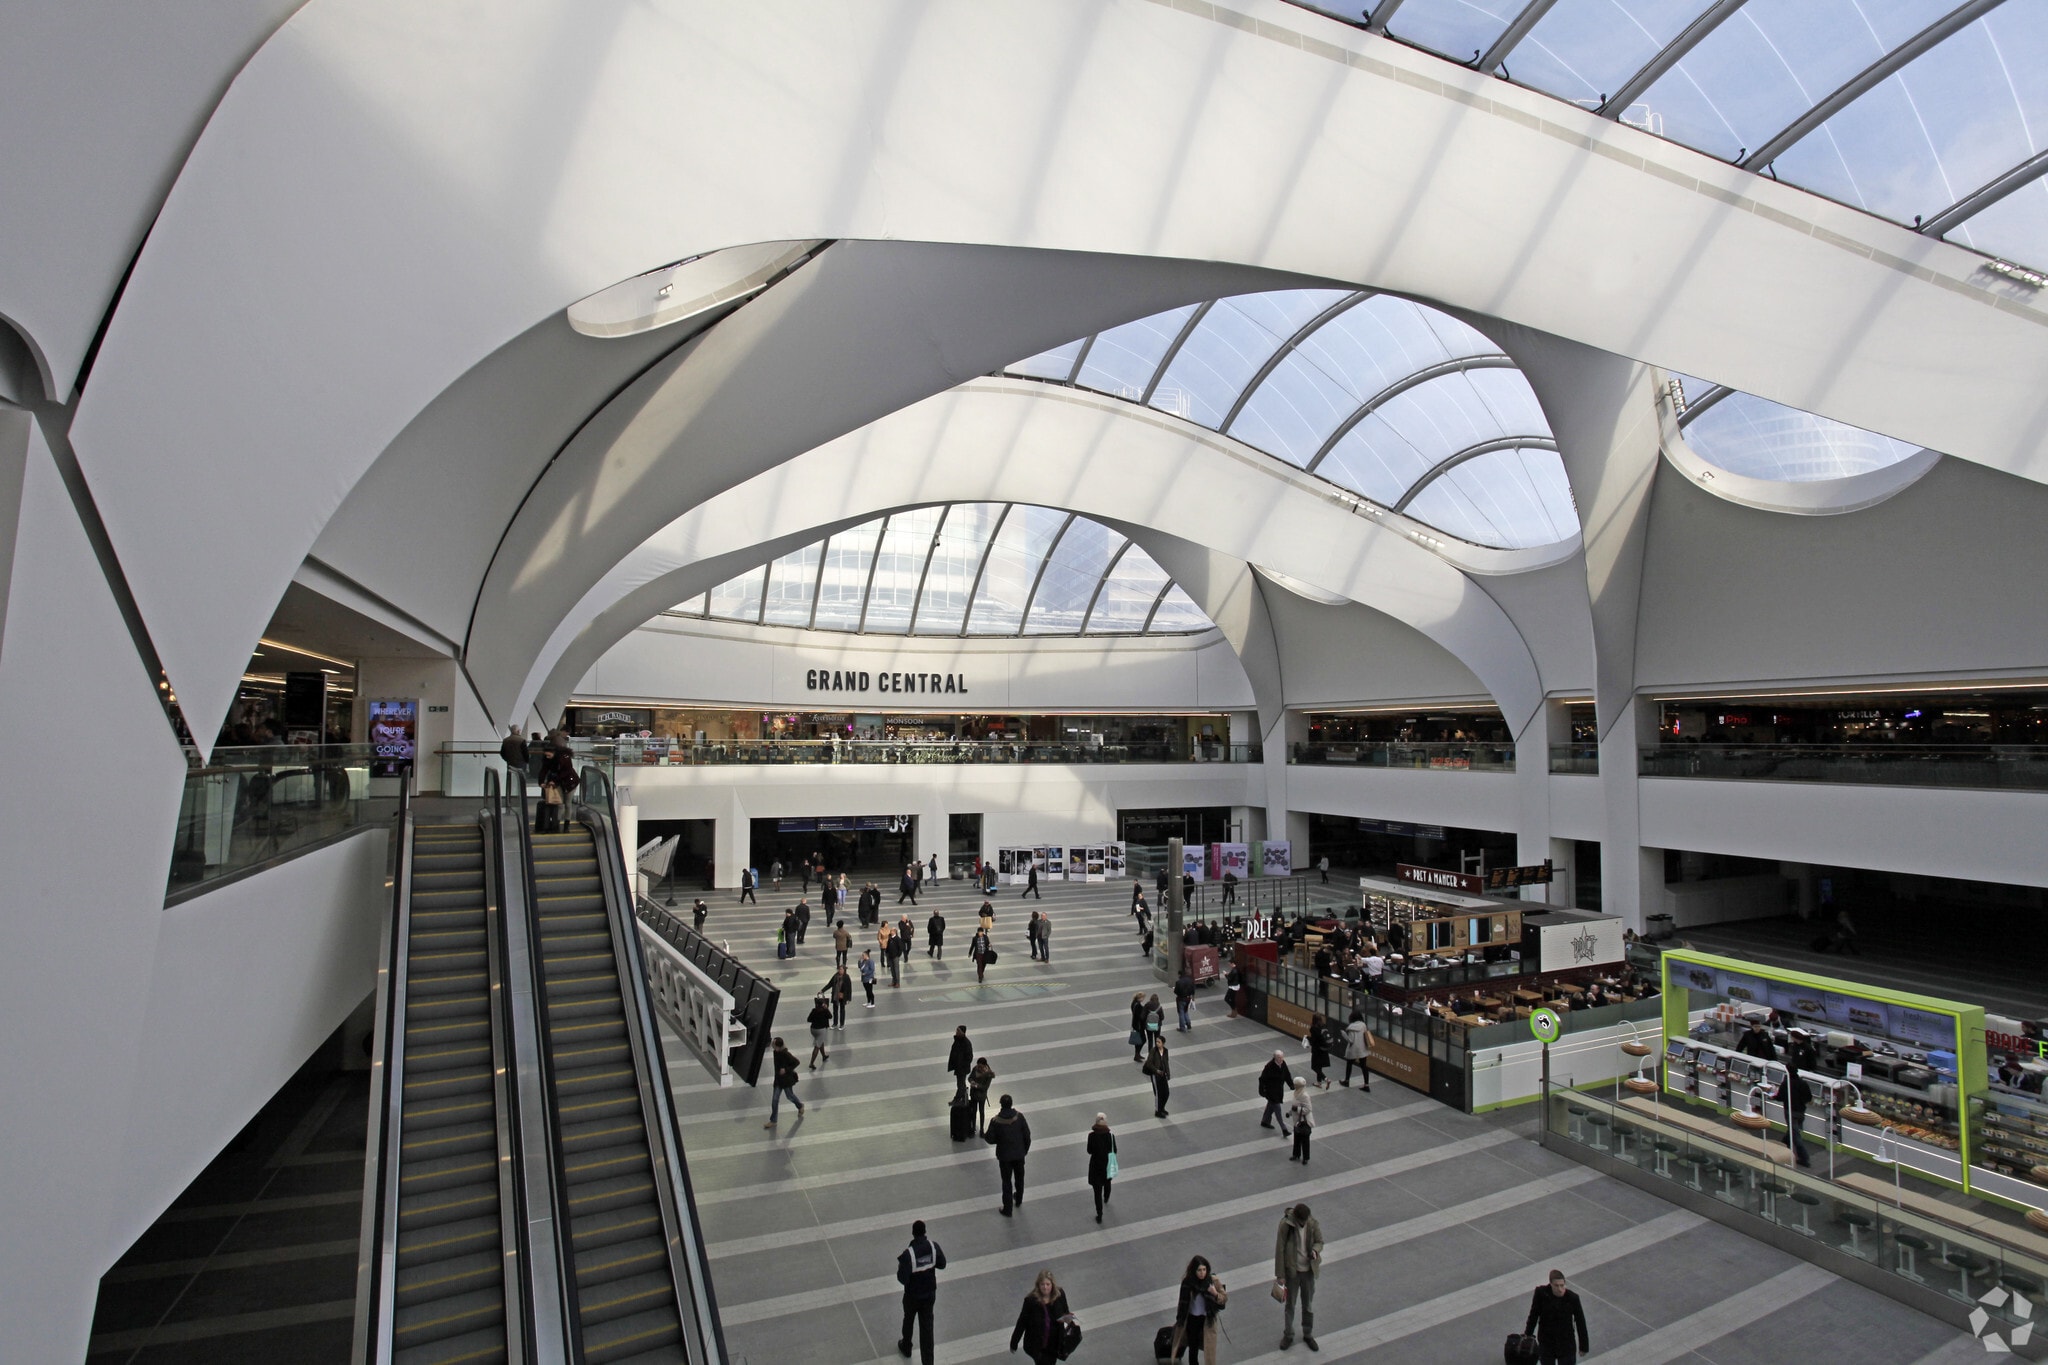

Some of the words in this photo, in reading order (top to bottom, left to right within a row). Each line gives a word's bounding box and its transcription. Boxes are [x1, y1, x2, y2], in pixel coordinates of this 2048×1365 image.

[806, 669, 870, 691] GRAND
[878, 672, 969, 694] CENTRAL
[374, 707, 412, 716] WHEREVER
[379, 726, 405, 735] YOU'RE
[376, 745, 406, 753] GOING
[1413, 868, 1427, 882] PRET
[1428, 871, 1433, 883] A
[1433, 872, 1458, 888] MANGER
[1247, 917, 1272, 940] PRET
[1276, 1012, 1297, 1025] ORGANIC
[1985, 1029, 2035, 1056] MADE
[1396, 1061, 1412, 1072] FOOD
